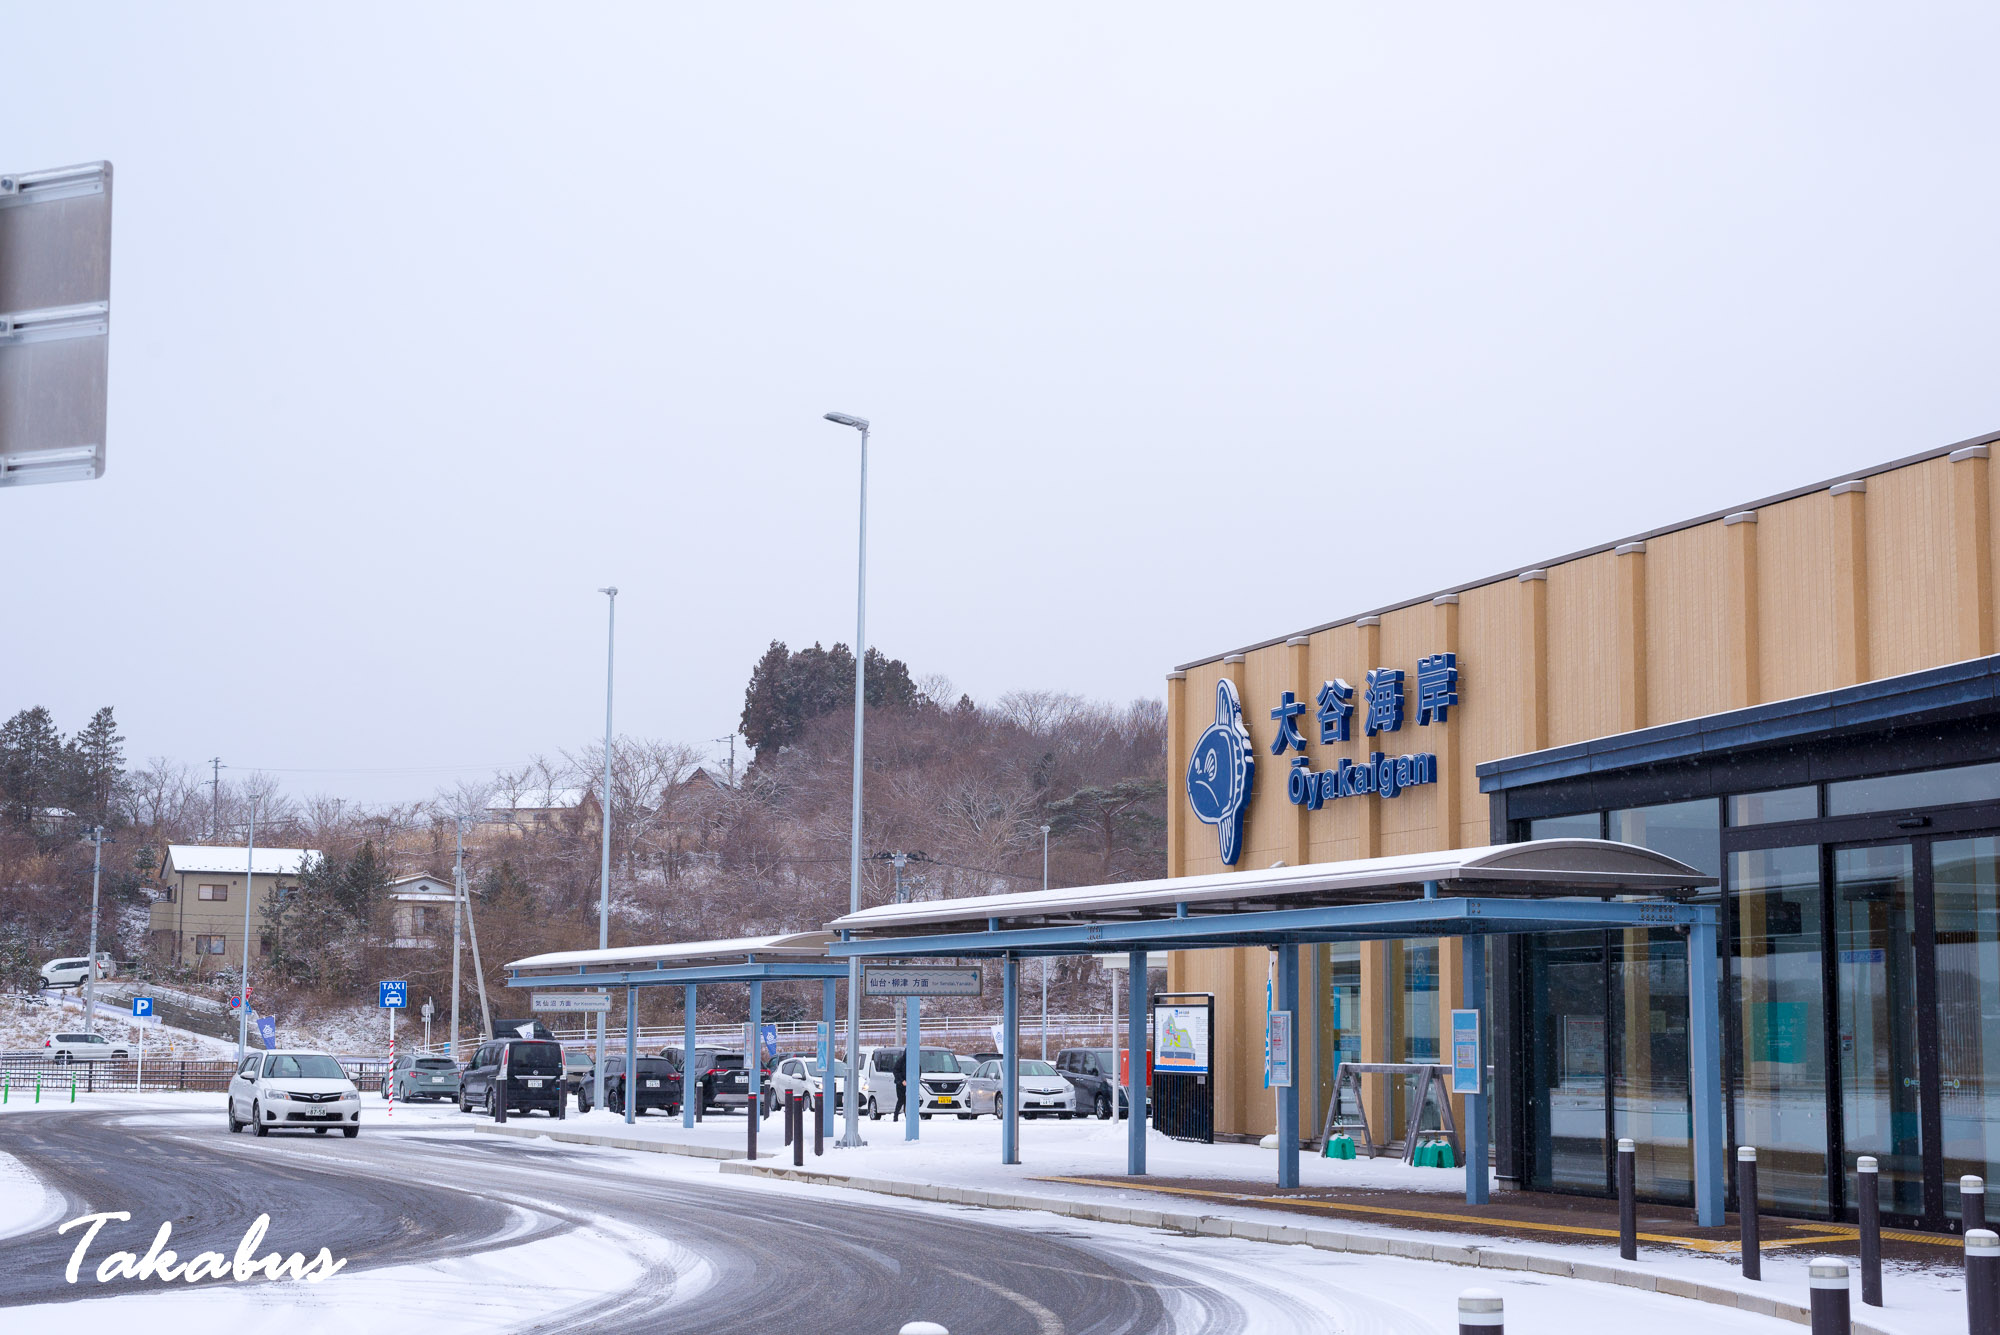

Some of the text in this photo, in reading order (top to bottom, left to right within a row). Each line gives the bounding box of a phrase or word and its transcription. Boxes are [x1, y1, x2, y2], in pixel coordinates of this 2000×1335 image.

[1270, 652, 1458, 756] 大谷海岸
[382, 982, 405, 990] TAXI
[912, 978, 929, 988] 方面
[136, 999, 149, 1015] P
